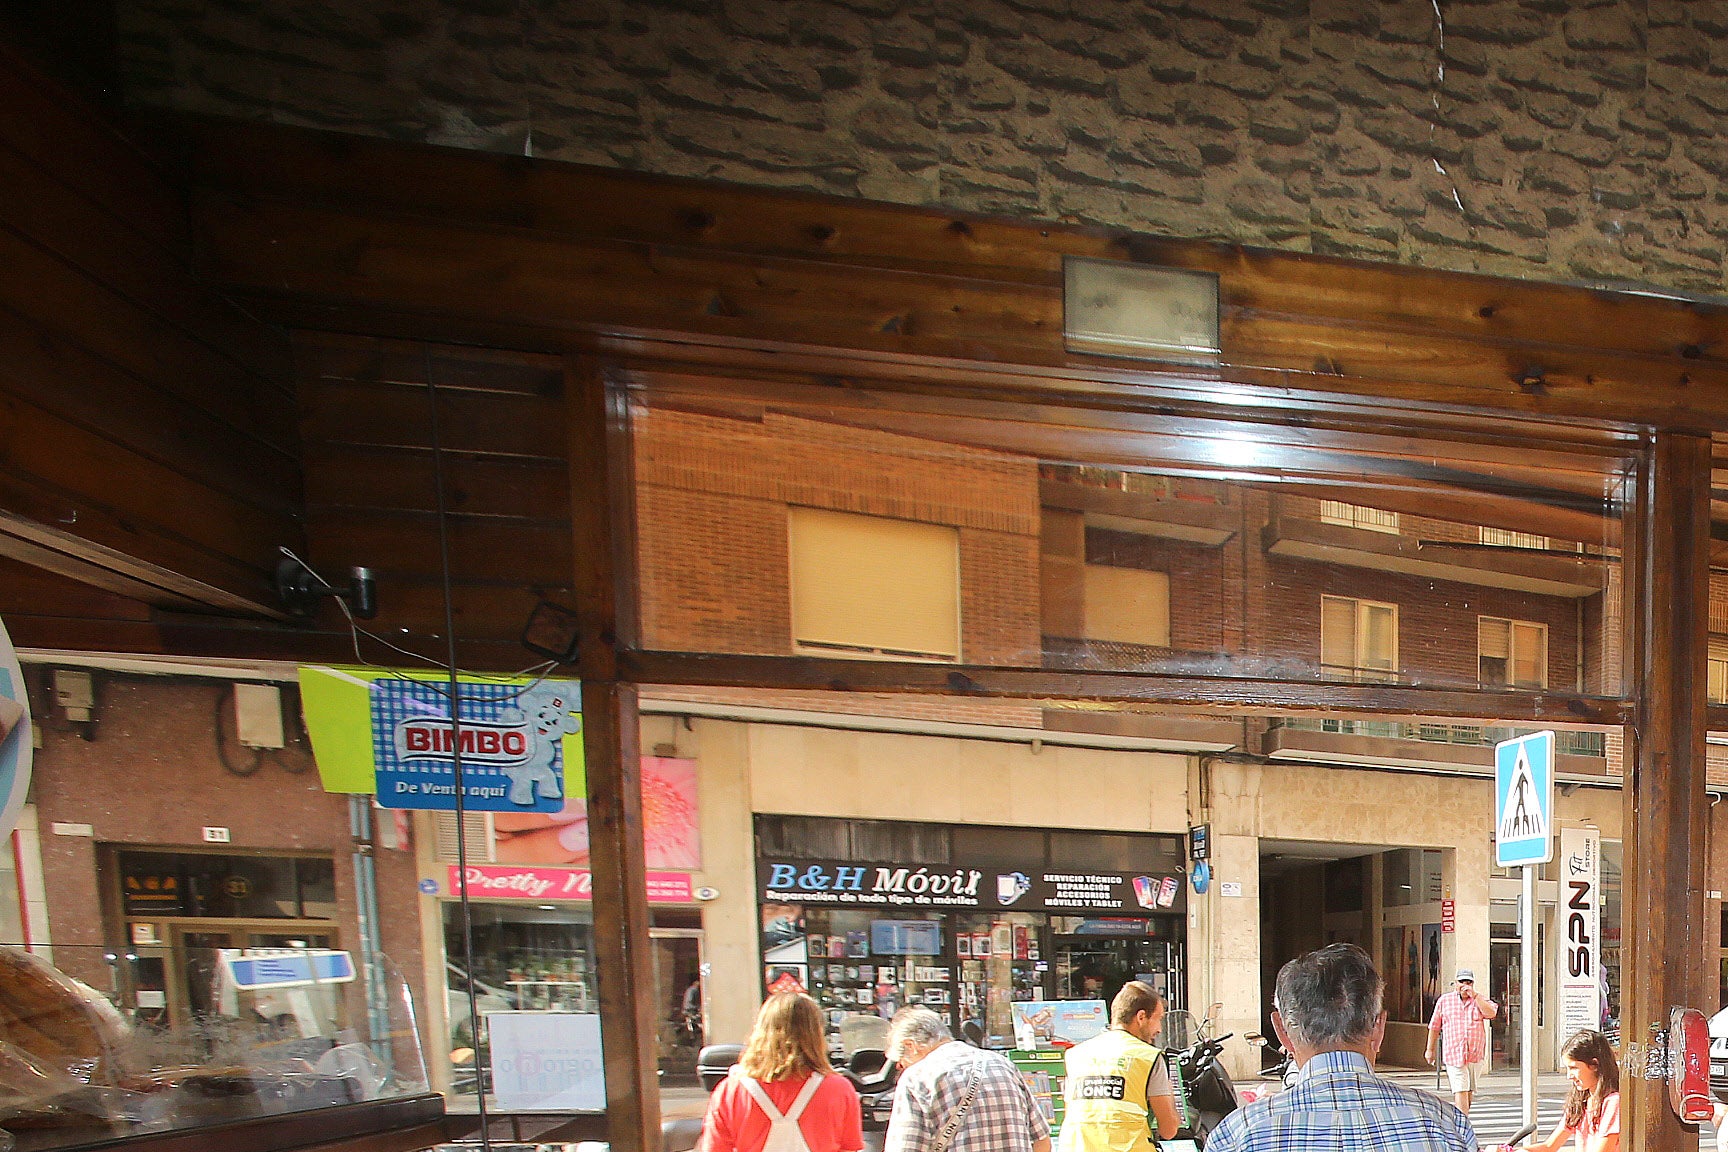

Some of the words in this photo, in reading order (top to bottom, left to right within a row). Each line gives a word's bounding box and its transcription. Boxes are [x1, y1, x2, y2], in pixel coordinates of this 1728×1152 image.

[405, 727, 527, 756] BIMBO
[396, 781, 418, 794] De
[470, 784, 506, 799] aquí
[455, 867, 554, 897] Pretty
[766, 863, 868, 891] B&H
[1043, 874, 1084, 883] SERVICIO
[1085, 874, 1123, 884] TÉCNICO
[1056, 883, 1111, 892] REPARACIÓN
[766, 890, 838, 903] Reparación
[839, 891, 857, 903] de
[1056, 891, 1111, 900] ACCESORIOS
[1044, 898, 1084, 907] MÓVILES
[1092, 900, 1123, 908] TABLET
[1568, 880, 1591, 978] SPN
[1084, 1085, 1123, 1099] ONCE
